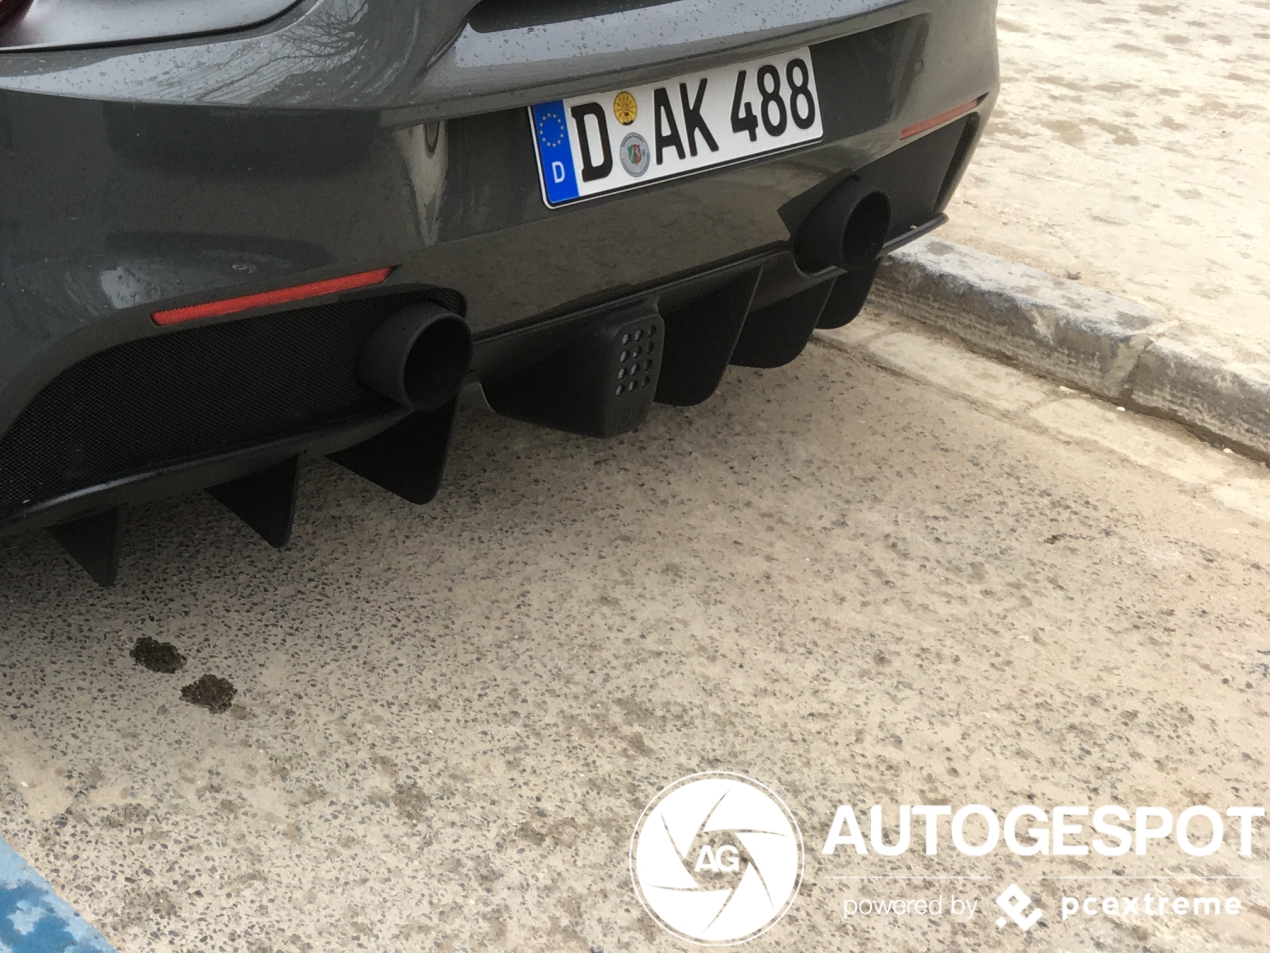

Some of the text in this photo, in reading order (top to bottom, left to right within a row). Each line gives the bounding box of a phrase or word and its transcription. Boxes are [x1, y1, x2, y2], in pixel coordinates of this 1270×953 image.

[570, 101, 613, 183] D
[652, 76, 720, 166] AK
[730, 57, 816, 142] 488
[551, 160, 566, 184] D
